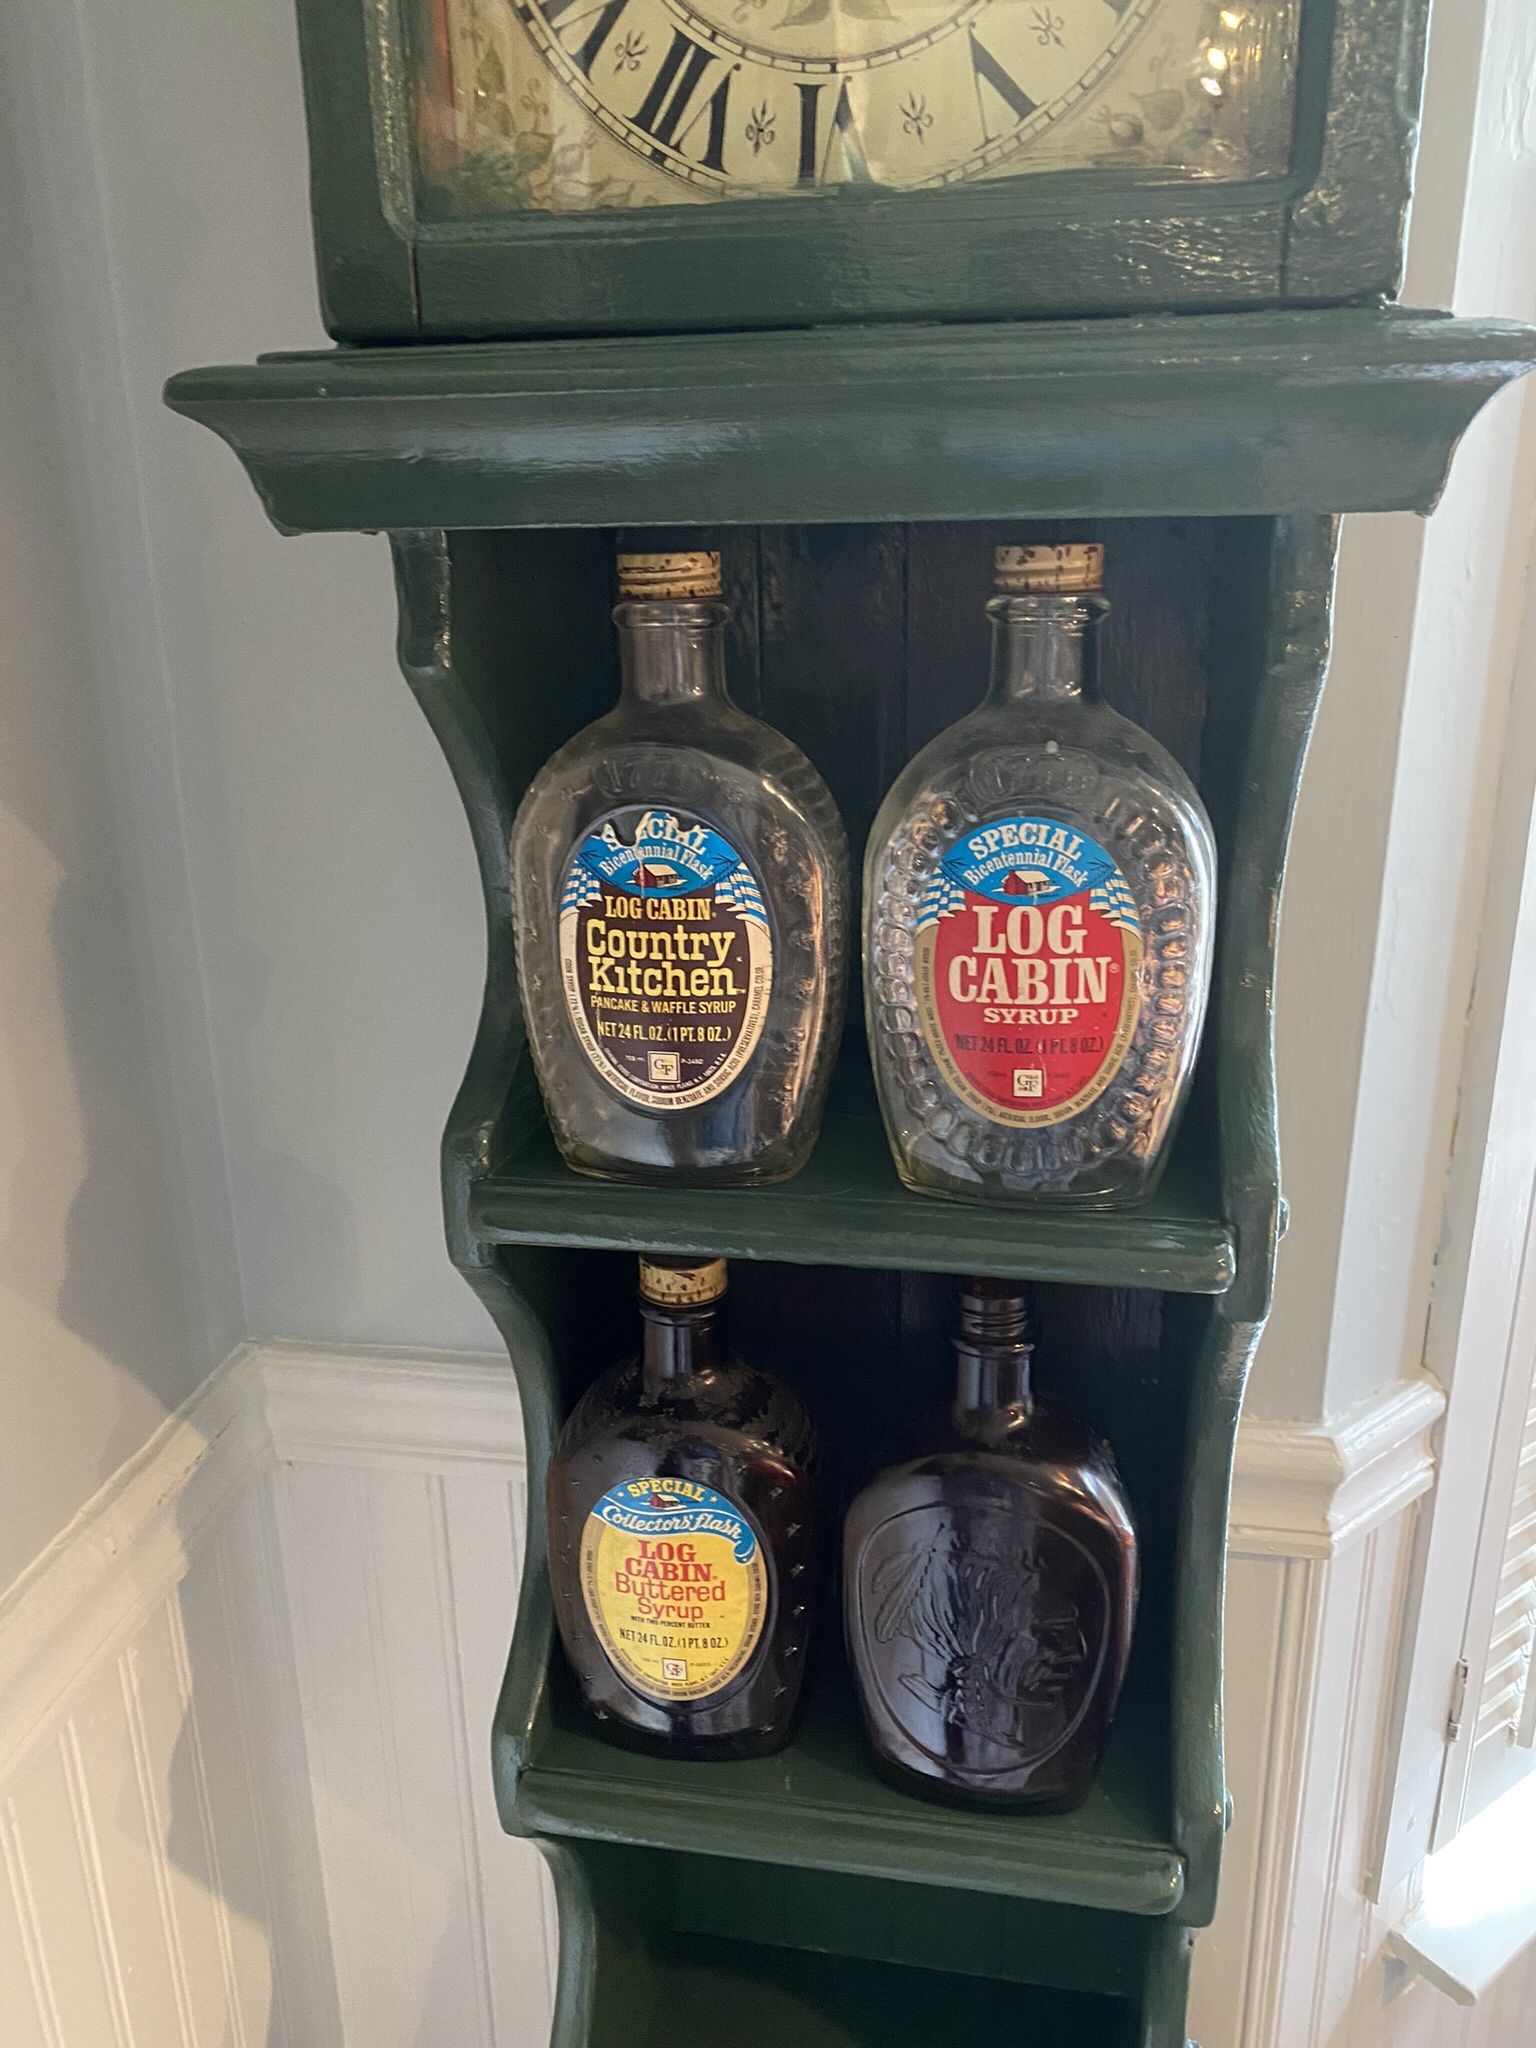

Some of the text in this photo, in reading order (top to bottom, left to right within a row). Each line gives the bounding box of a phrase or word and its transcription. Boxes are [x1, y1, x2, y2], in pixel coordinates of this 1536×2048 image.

[968, 822, 1085, 861] SPECIAL
[680, 848, 714, 880] Flask
[963, 849, 1089, 888] Bicentennial Flask
[605, 895, 711, 921] LOG CABIN
[972, 905, 1088, 955] LOG
[586, 918, 736, 968] Country
[588, 955, 738, 997] Kitchen
[948, 955, 1112, 1005] CABIN
[591, 995, 737, 1014] PANCAKE & WAFFLE SYRUP
[983, 1007, 1079, 1025] SYRUP
[599, 1021, 617, 1037] NET
[618, 1023, 632, 1039] 24
[681, 1027, 696, 1042] PT.
[698, 1027, 705, 1042] 8
[954, 1034, 977, 1051] NET
[981, 1036, 994, 1053] 24
[1070, 1038, 1077, 1053] 8
[627, 1479, 705, 1501] SPECIAL
[638, 1540, 697, 1562] LOG
[625, 1557, 713, 1582] CABIN
[615, 1572, 726, 1601] Buttered
[630, 1615, 645, 1623] WITH
[660, 1620, 685, 1628] PERCENT
[638, 1597, 704, 1622] Syrup
[619, 1628, 635, 1642] NET
[637, 1632, 648, 1643] 24
[702, 1638, 708, 1649] 8
